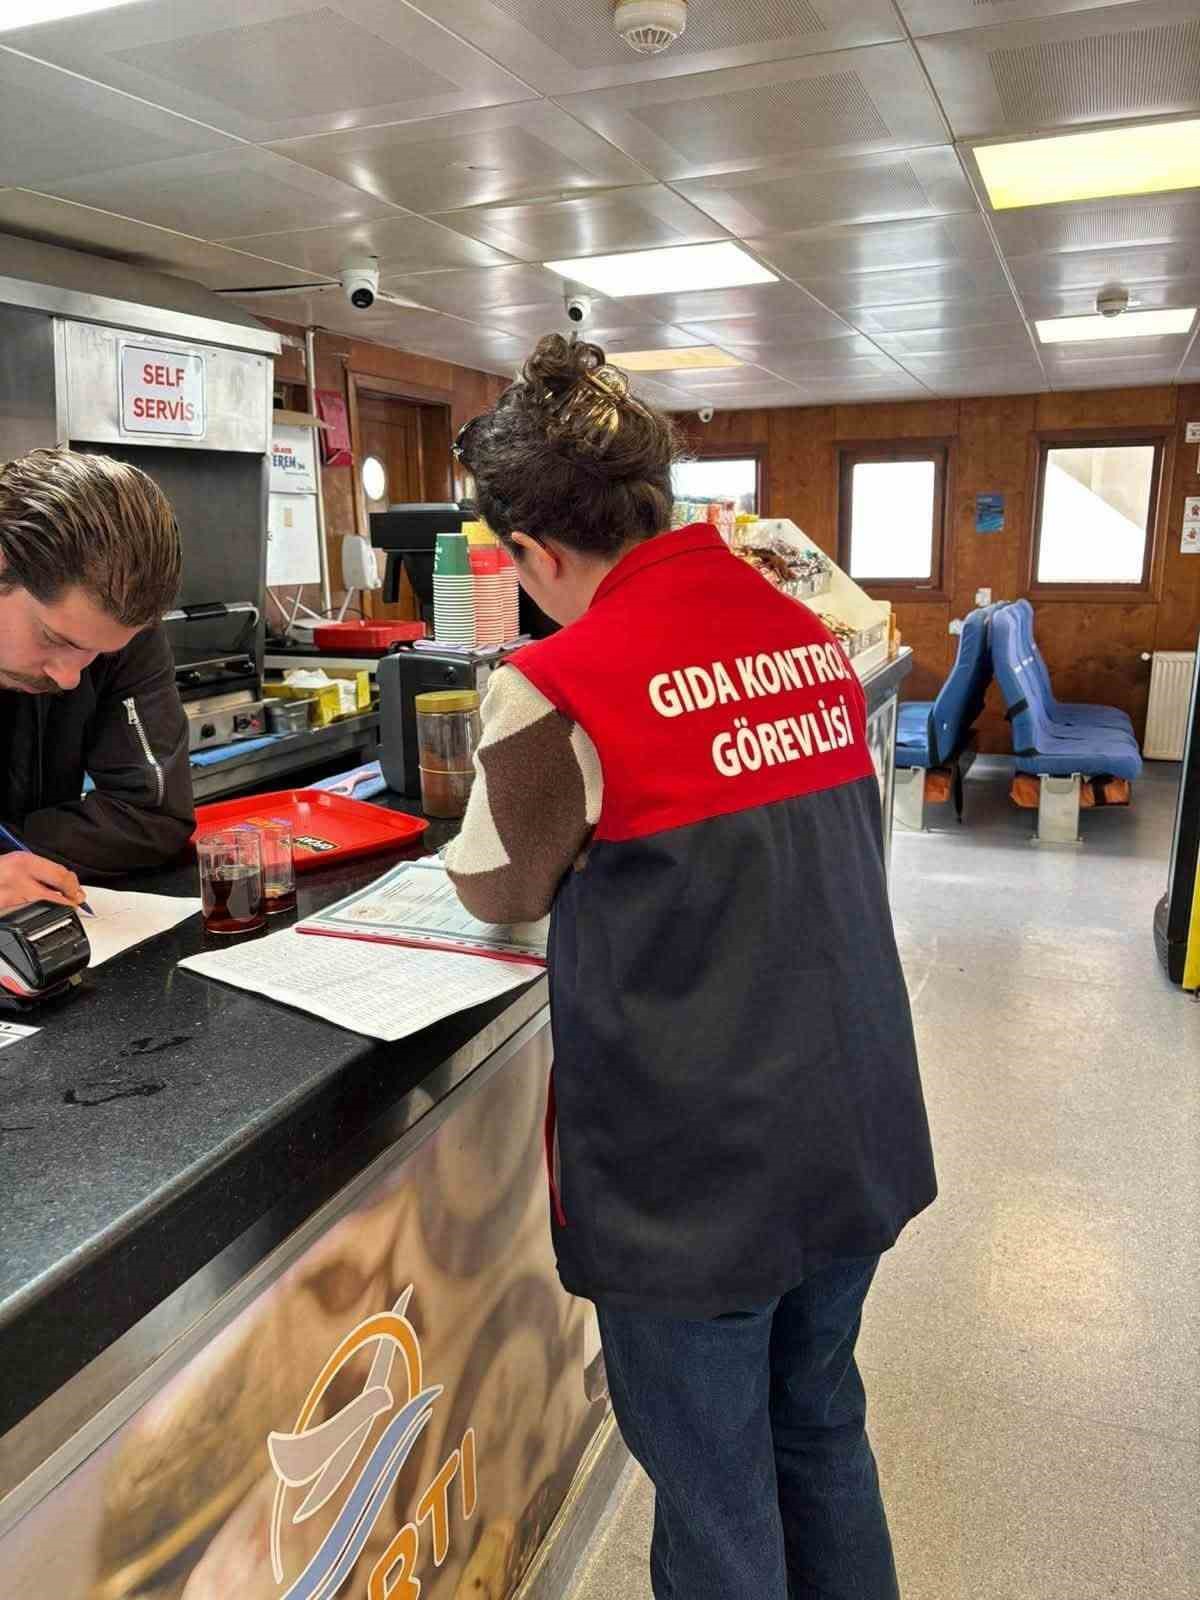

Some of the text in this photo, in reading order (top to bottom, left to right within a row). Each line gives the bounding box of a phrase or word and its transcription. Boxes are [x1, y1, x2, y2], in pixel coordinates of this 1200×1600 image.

[143, 363, 185, 388] SELF
[133, 395, 195, 422] SERVİS
[648, 661, 740, 718] GIDA
[711, 694, 854, 777] GÖREVLİSİ
